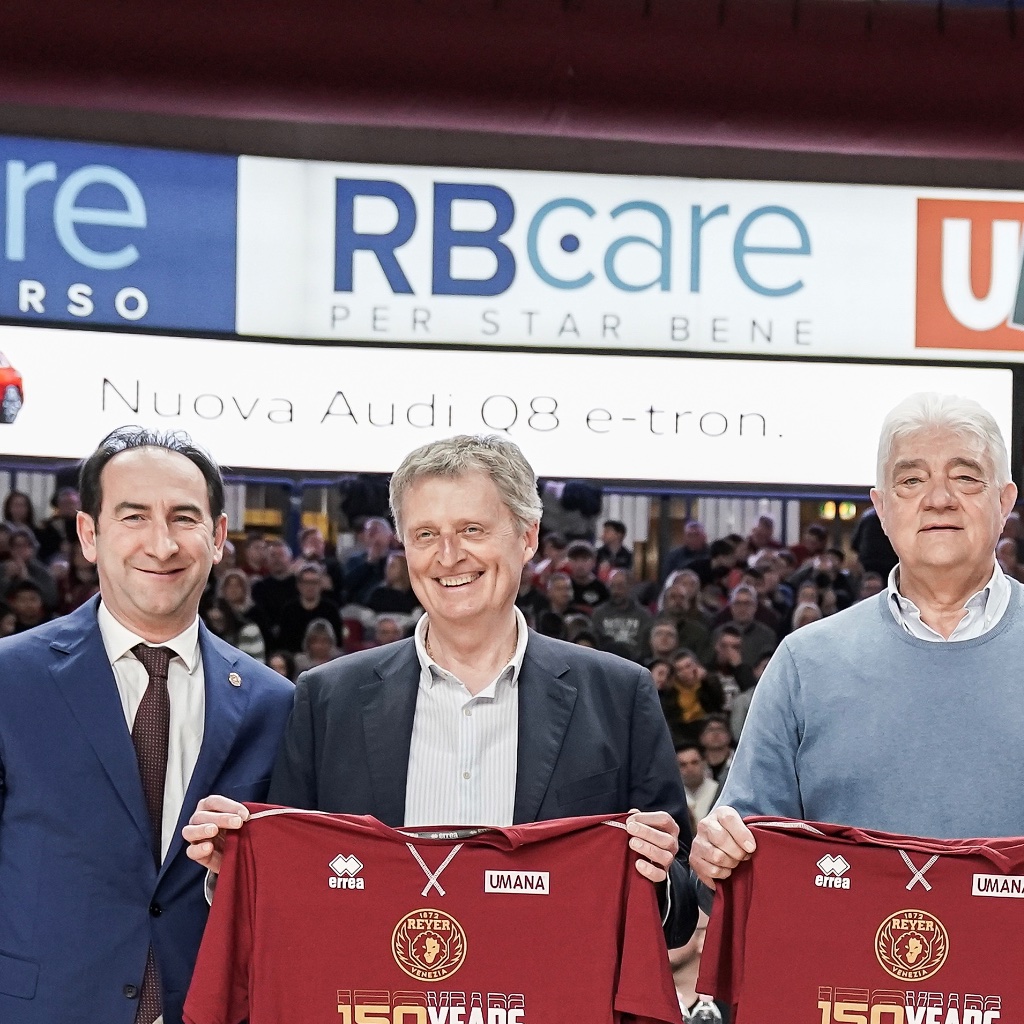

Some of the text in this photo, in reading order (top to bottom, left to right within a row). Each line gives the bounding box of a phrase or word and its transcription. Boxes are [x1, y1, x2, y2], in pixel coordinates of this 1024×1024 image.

[332, 176, 813, 298] RBcare
[331, 304, 813, 346] PER STAR BENE
[101, 376, 784, 438] Nuova Audi Q8 e-tron.
[328, 876, 365, 890] errea
[489, 875, 545, 890] UMANA
[815, 874, 850, 890] errea
[407, 919, 451, 930] REYER
[891, 918, 935, 931] REYER
[411, 966, 448, 979] VENEZIA
[892, 966, 928, 978] VENEZIA
